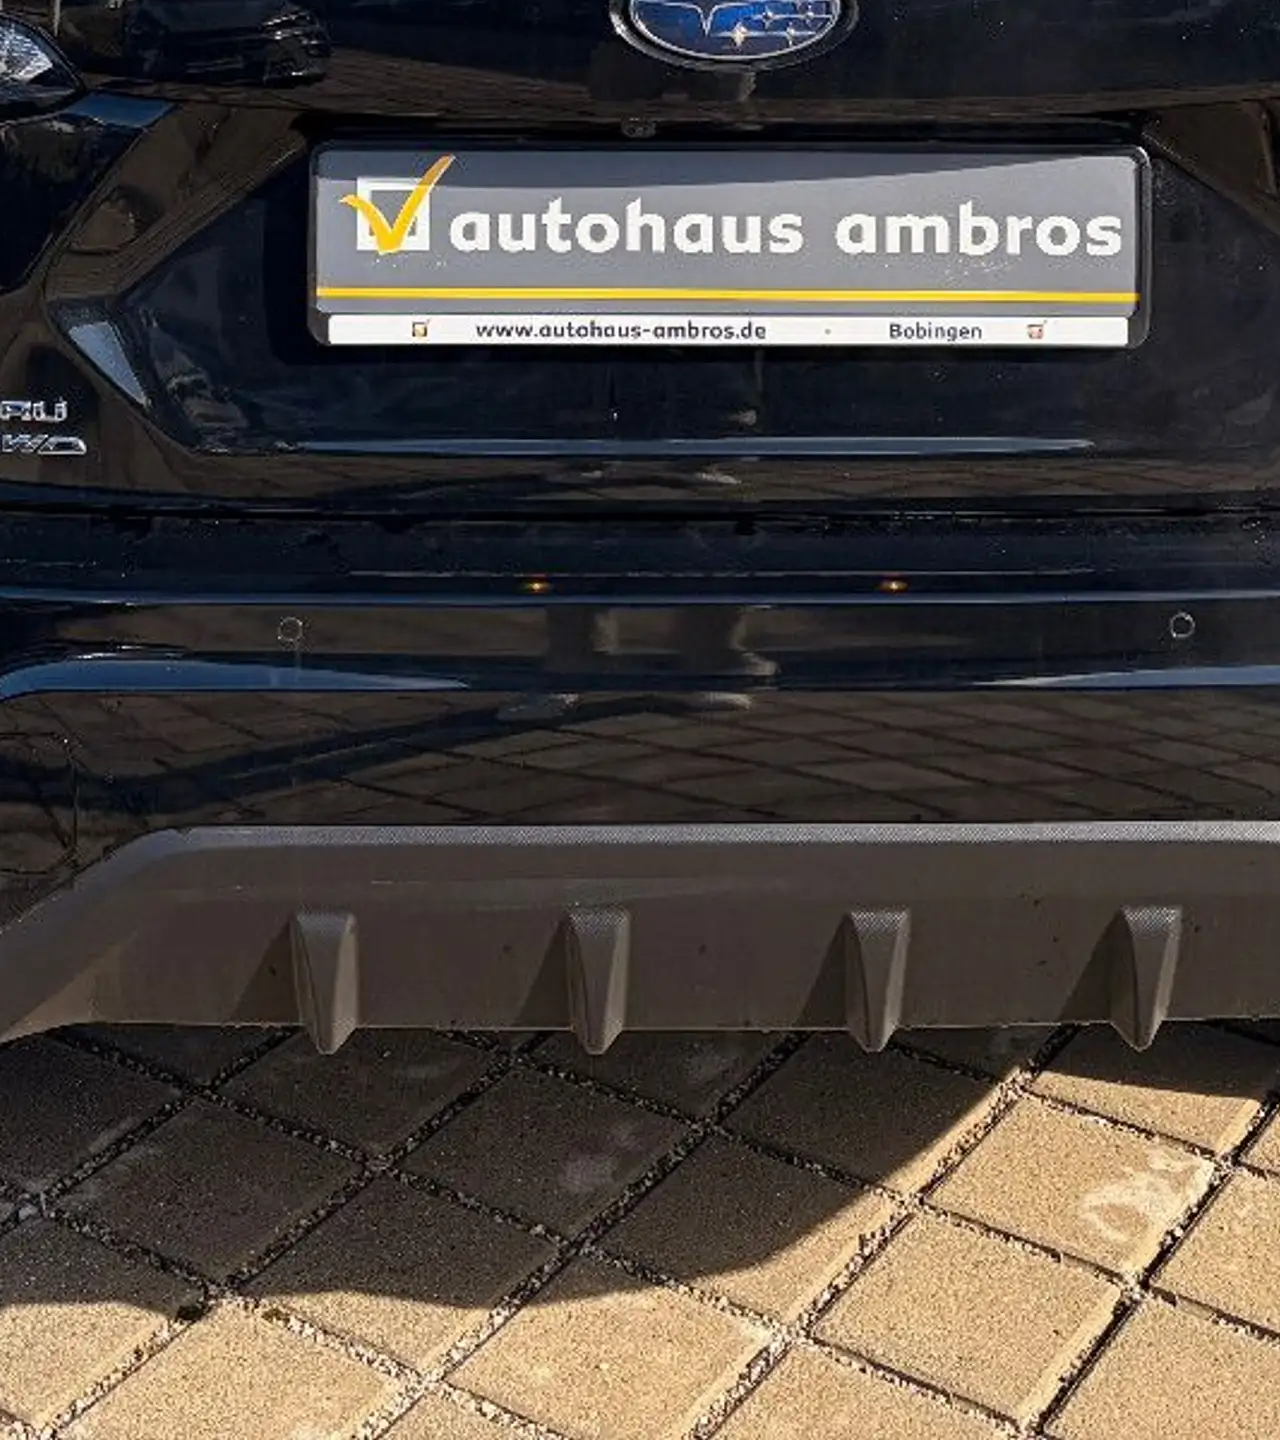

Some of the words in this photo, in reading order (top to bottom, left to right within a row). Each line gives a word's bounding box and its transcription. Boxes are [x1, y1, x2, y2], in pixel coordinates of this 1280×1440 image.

[450, 197, 804, 255] autohaus
[835, 201, 1123, 257] ambros
[476, 320, 767, 340] www.autohaus-ambros.de
[889, 322, 983, 342] Bobingen
